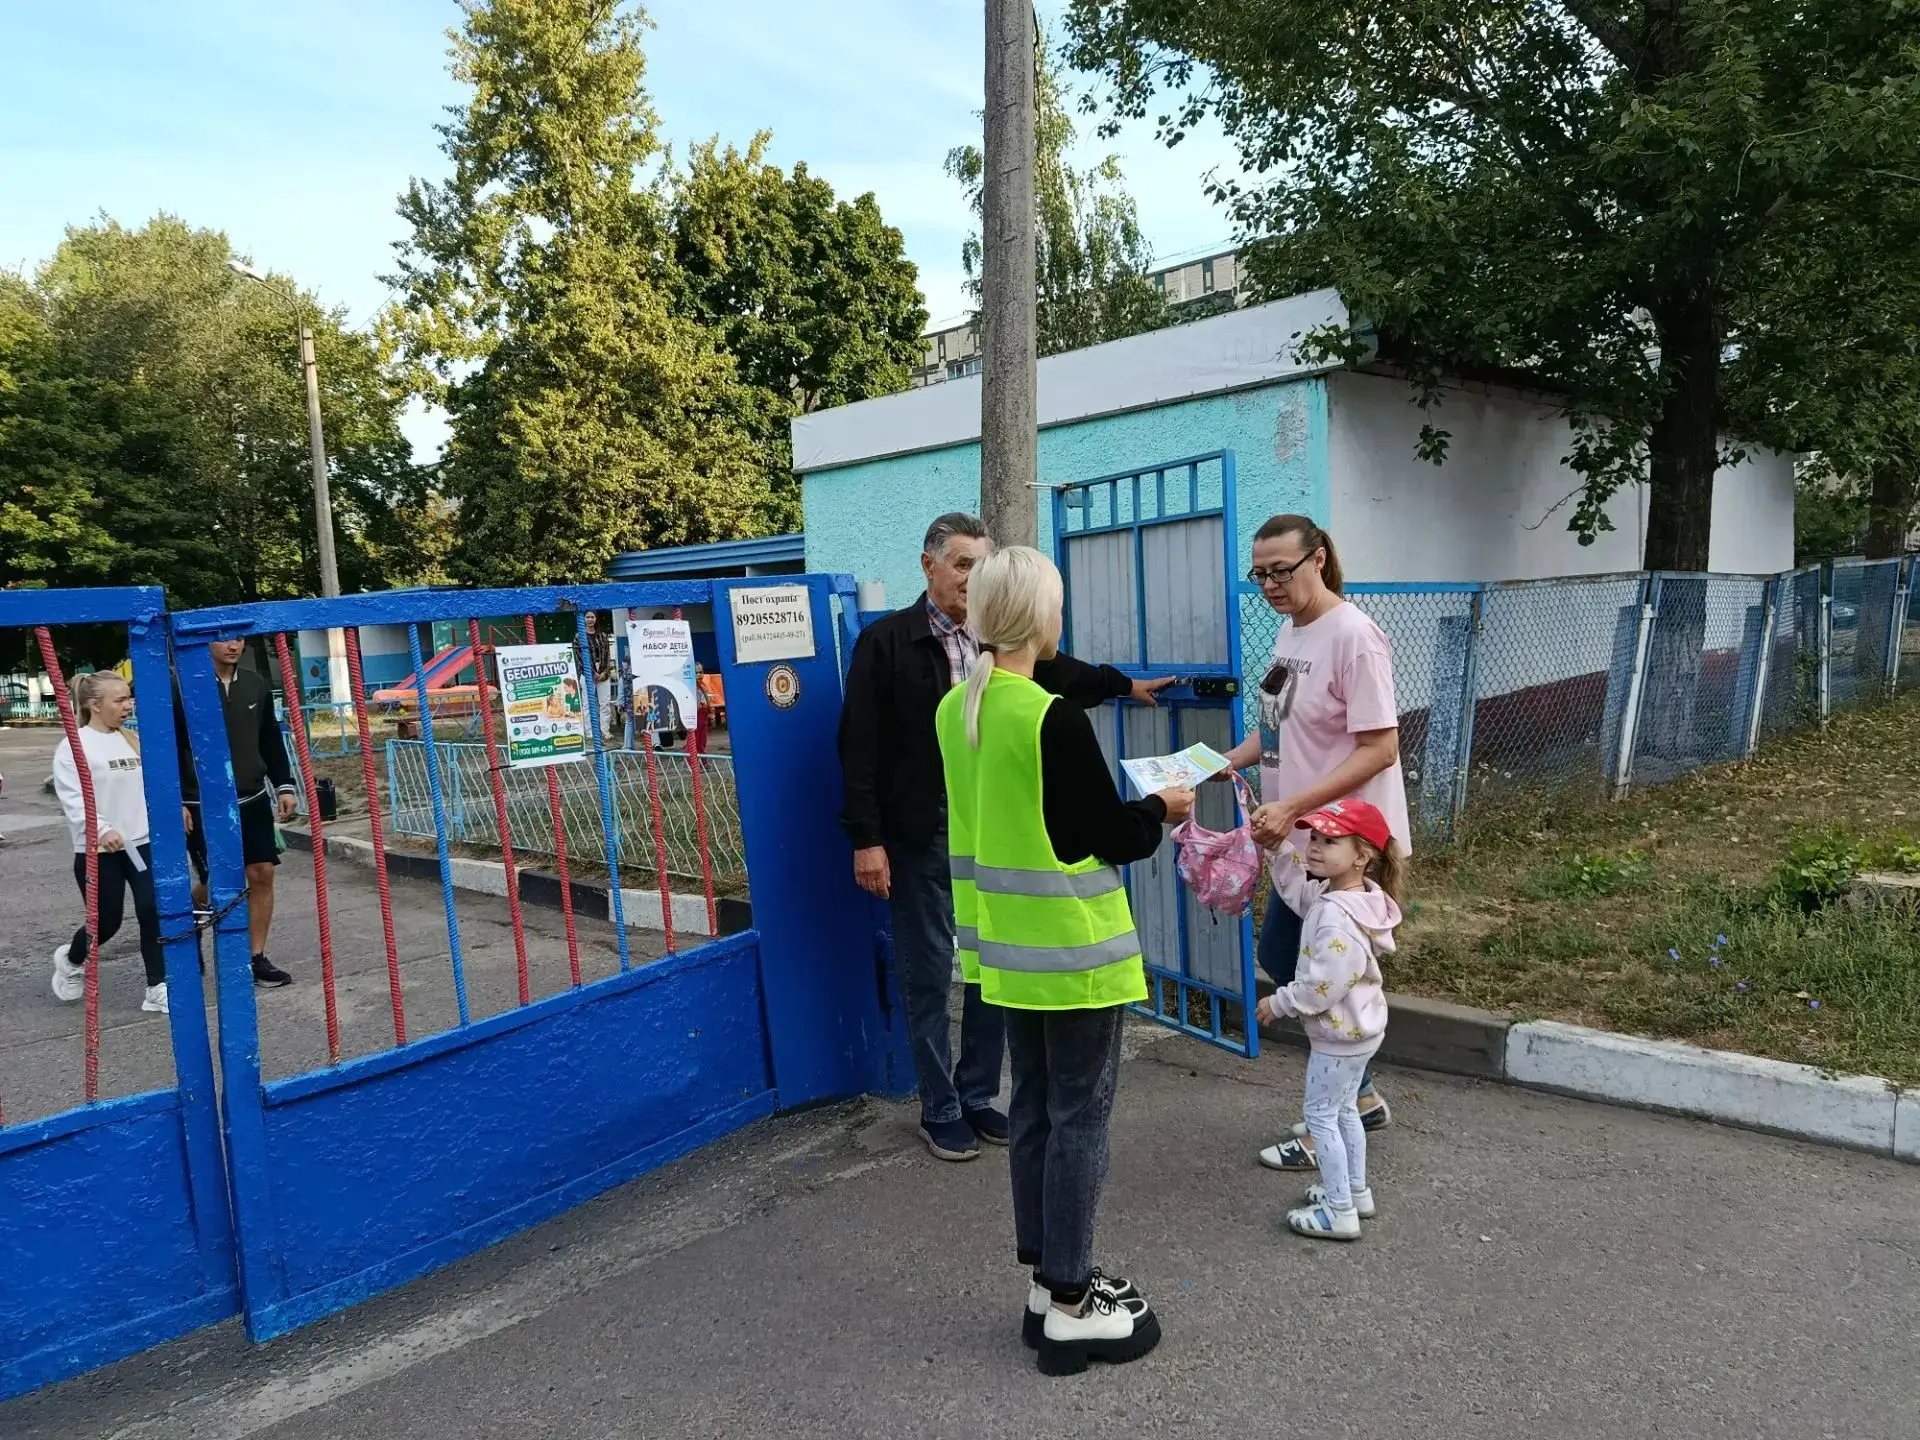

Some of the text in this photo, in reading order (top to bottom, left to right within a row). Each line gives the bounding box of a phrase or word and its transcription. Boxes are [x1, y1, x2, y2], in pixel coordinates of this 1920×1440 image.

[742, 594, 798, 605] Пост охраны
[736, 611, 805, 626] 89205528716
[643, 641, 689, 650] НАБОР ДЕТЕЙ
[506, 663, 567, 681] БЕСПЛАТНО
